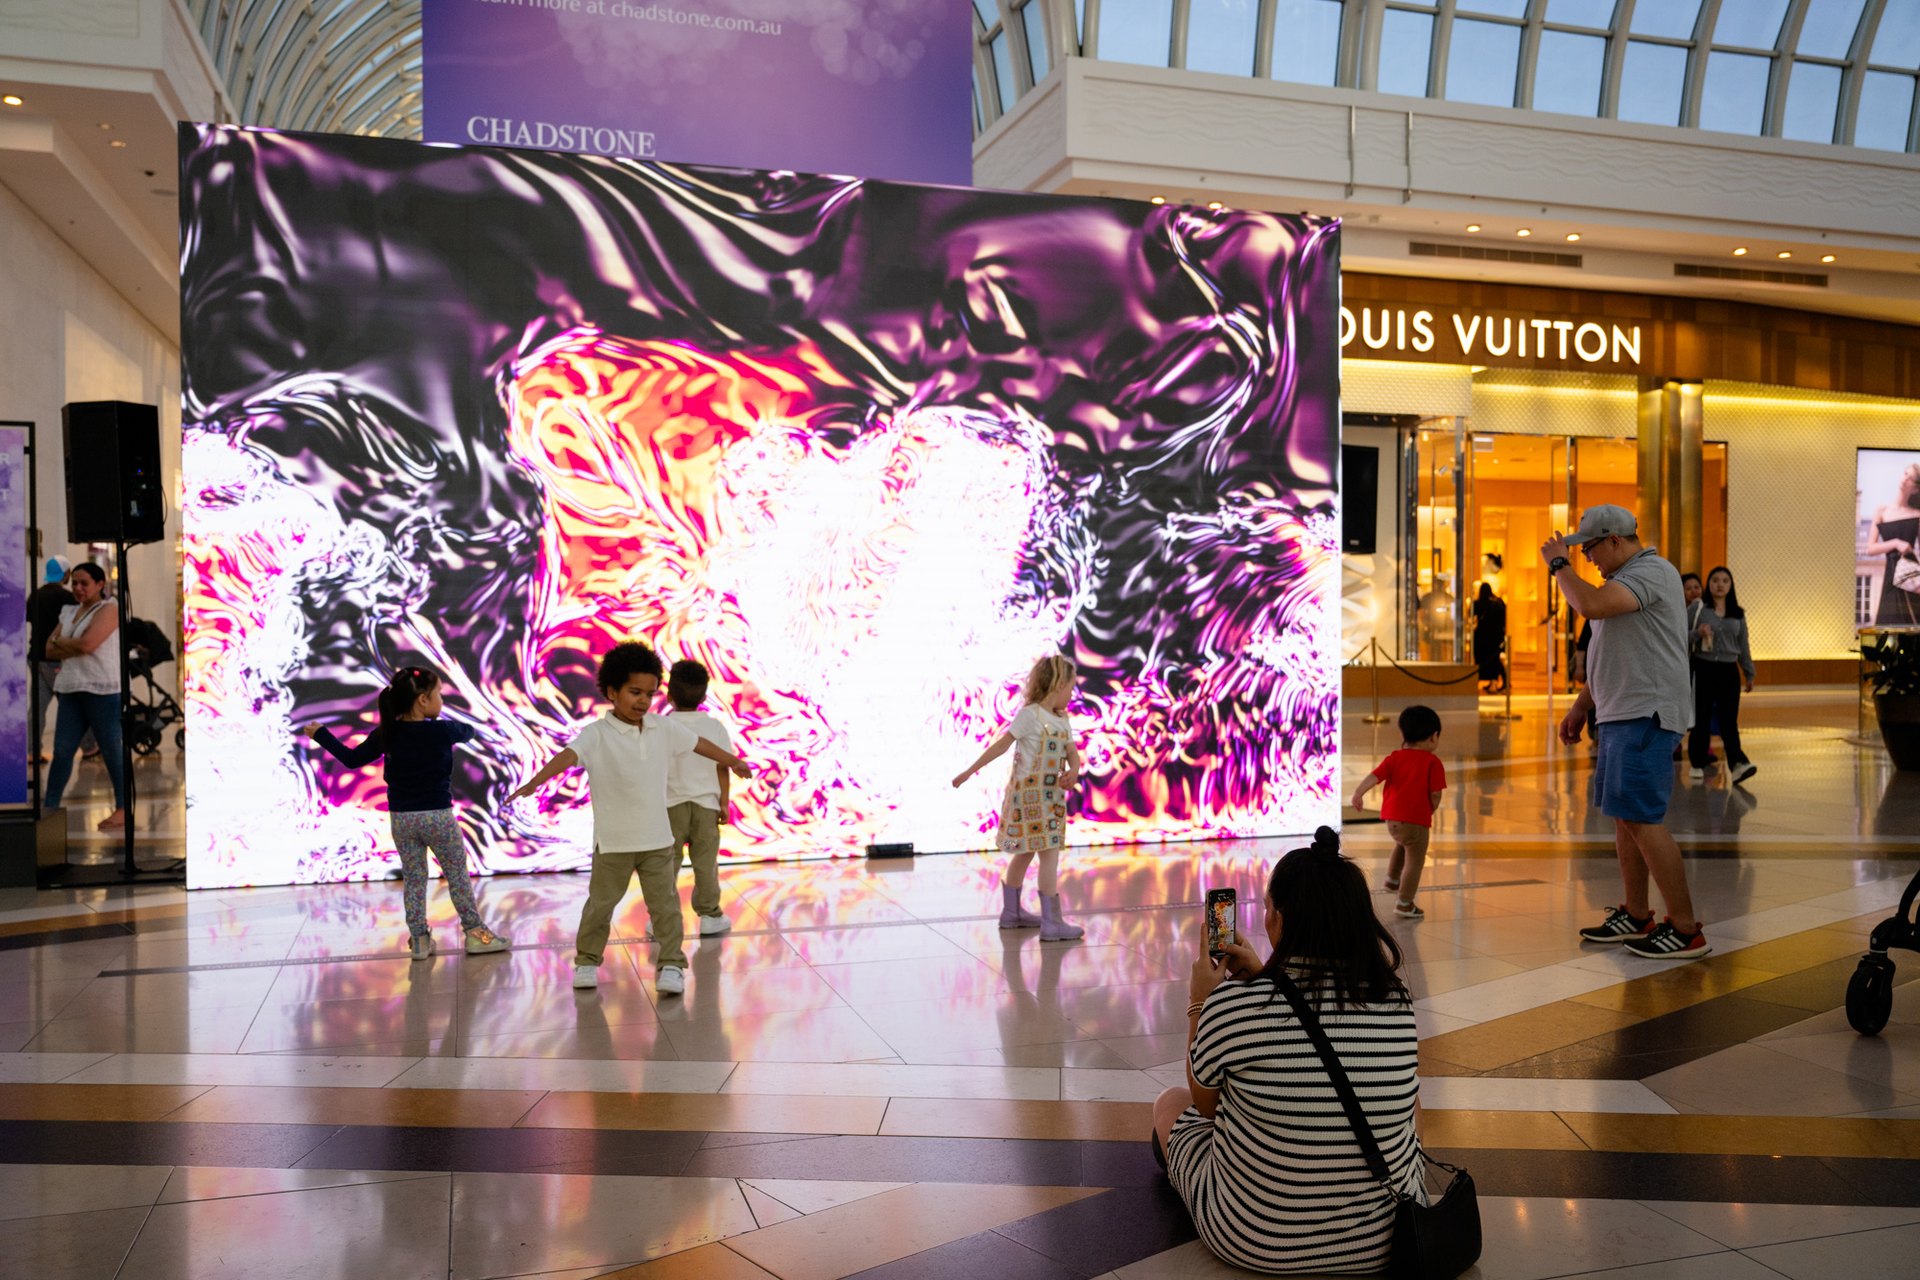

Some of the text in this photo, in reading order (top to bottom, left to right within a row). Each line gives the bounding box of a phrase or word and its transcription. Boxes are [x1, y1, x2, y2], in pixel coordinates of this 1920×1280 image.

[586, 0, 606, 15] at
[610, 1, 782, 36] chadstone.com.au
[467, 115, 656, 157] CHADSTONE
[1452, 313, 1640, 365] VUITTON
